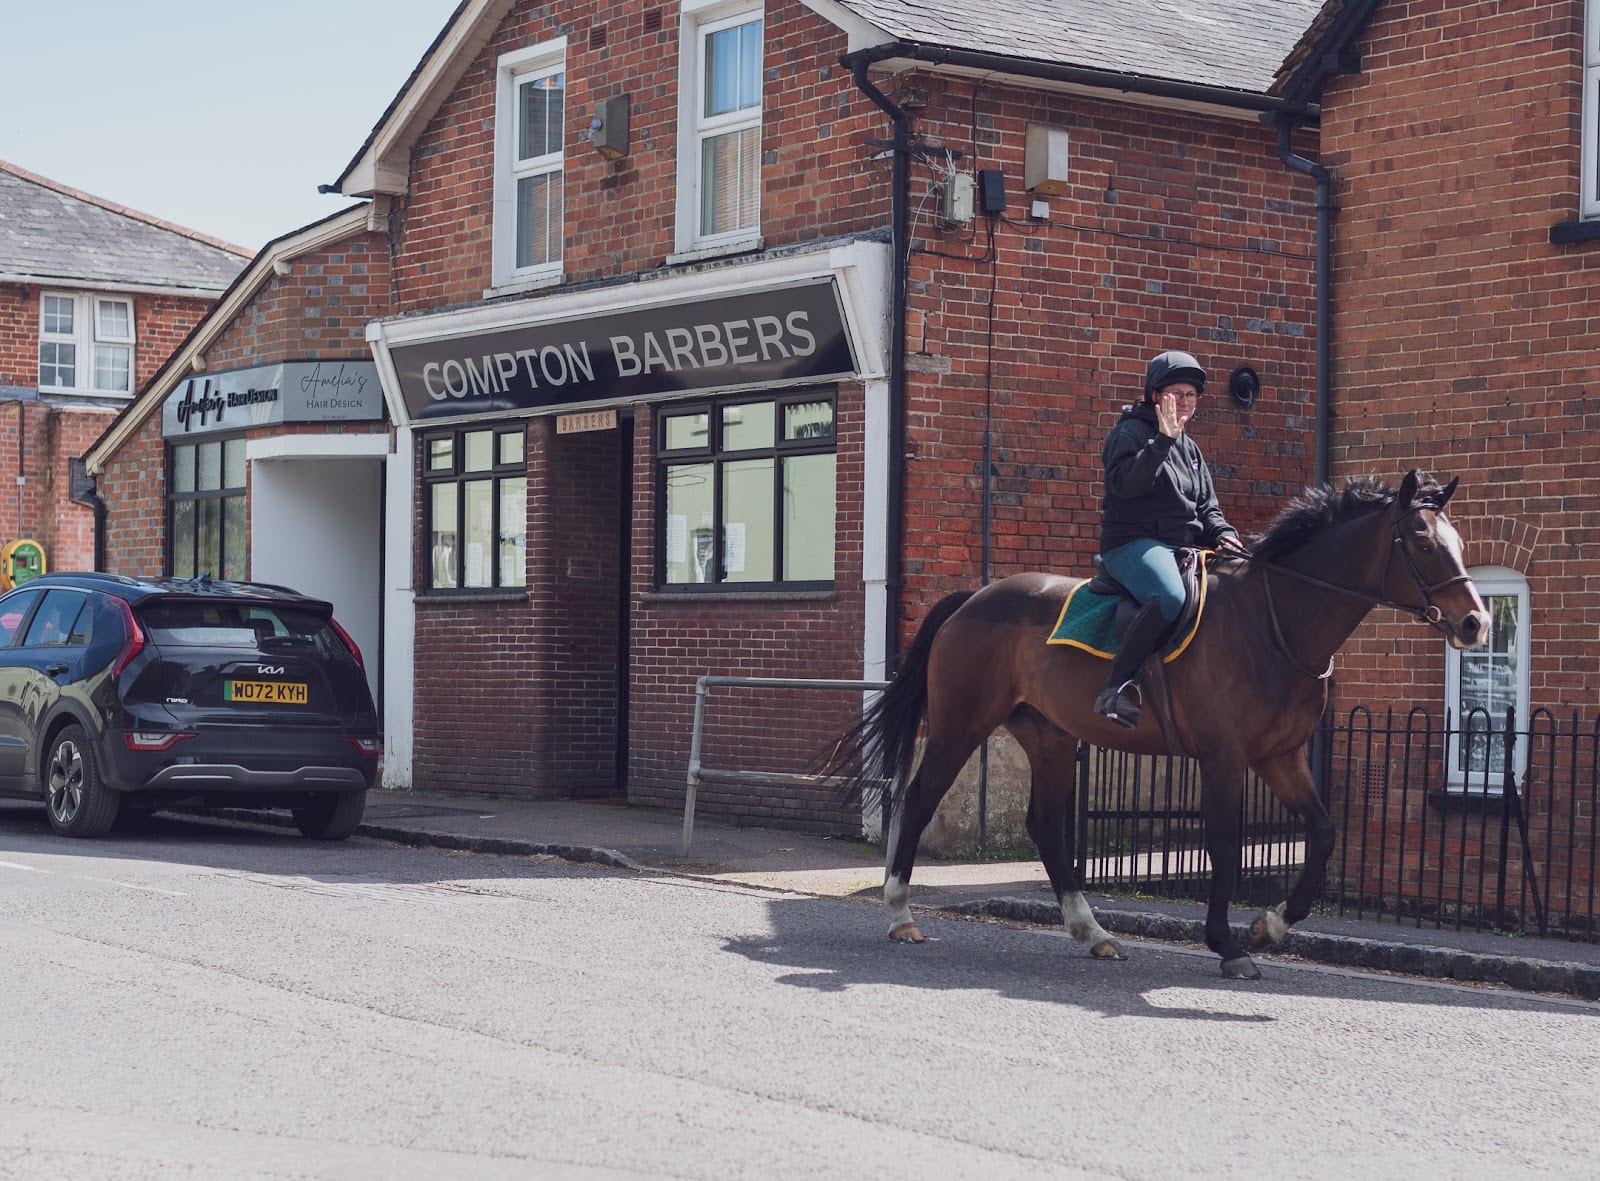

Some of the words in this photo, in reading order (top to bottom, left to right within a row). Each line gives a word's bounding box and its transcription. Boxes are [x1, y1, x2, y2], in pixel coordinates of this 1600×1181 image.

[423, 341, 595, 401] COMPTON
[609, 310, 816, 377] BARBERS
[301, 363, 368, 398] Amelia's
[306, 399, 328, 409] HAIR
[330, 398, 363, 409] DESIGN
[562, 412, 612, 432] BARBERS
[234, 683, 274, 699] WO72
[277, 684, 305, 701] KYH
